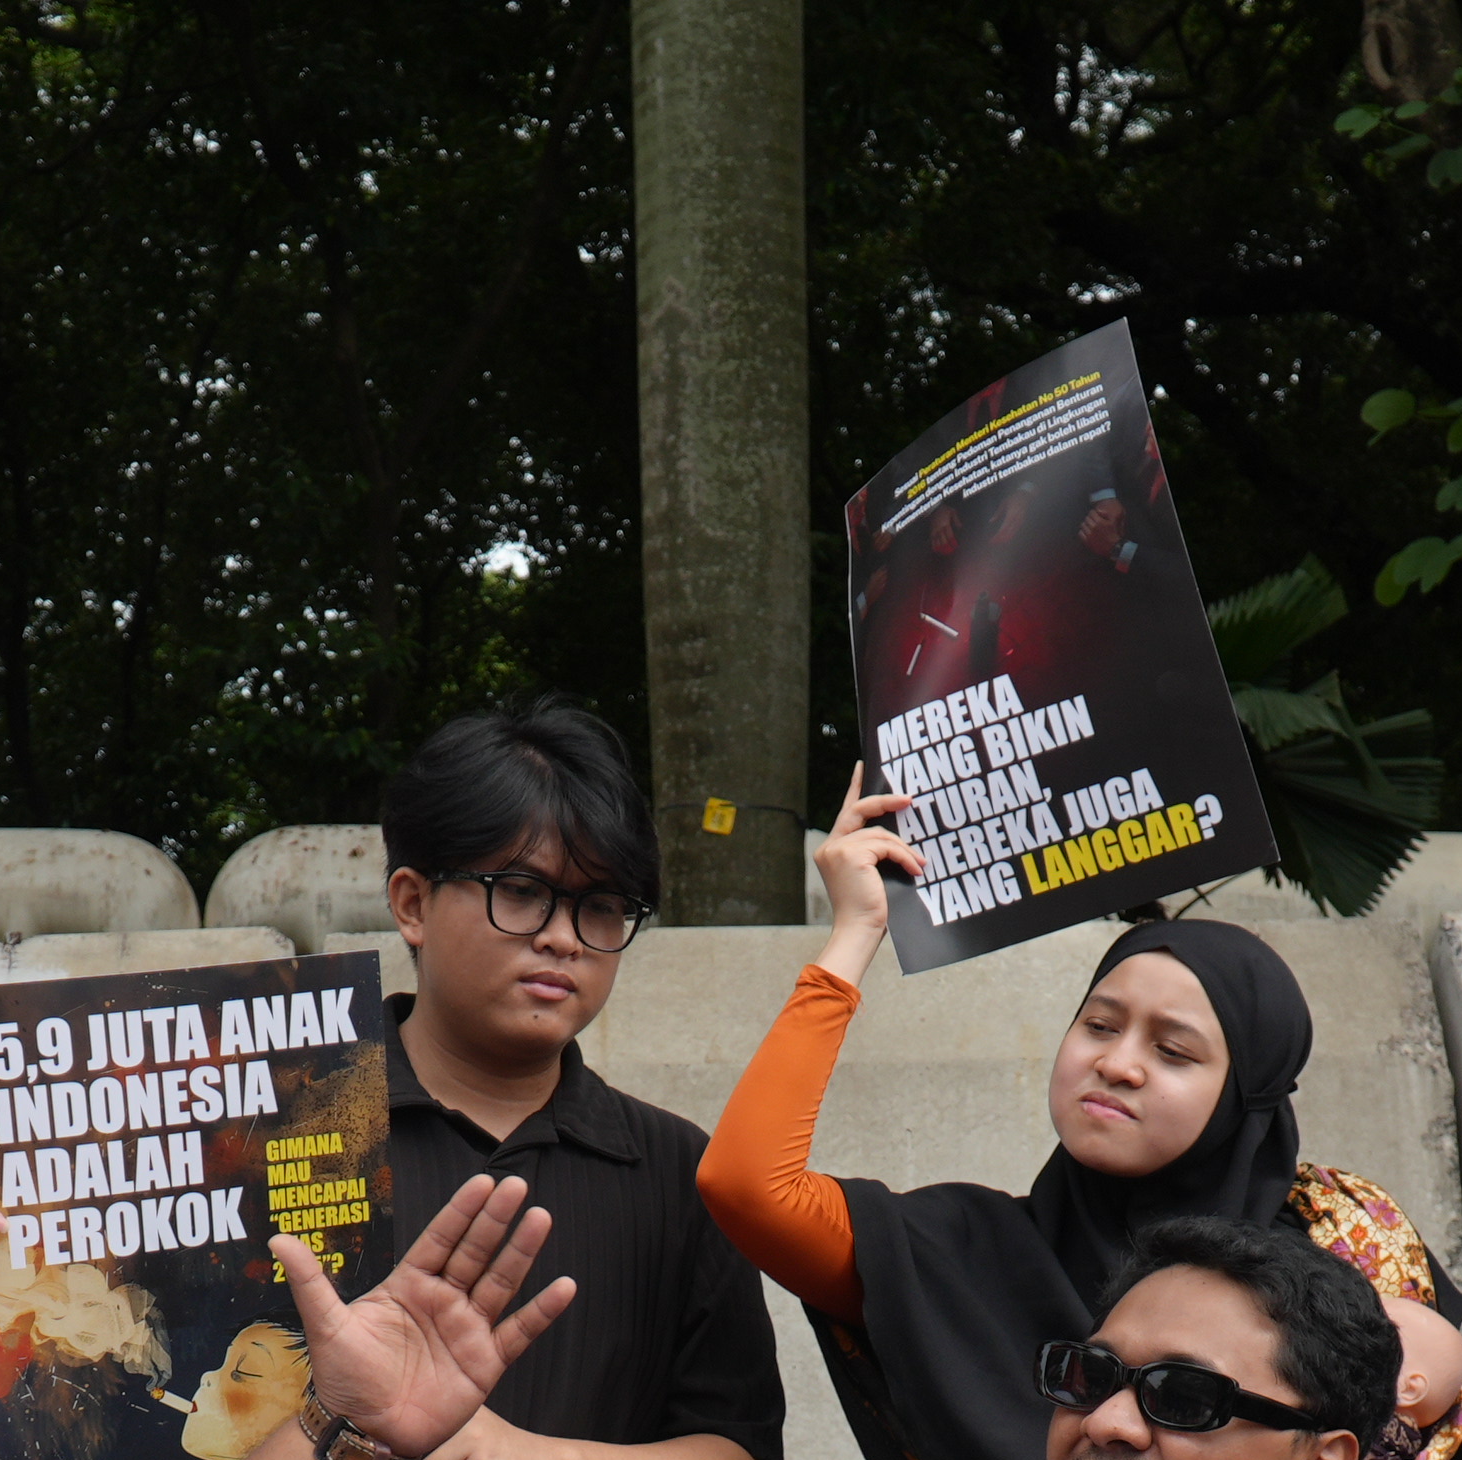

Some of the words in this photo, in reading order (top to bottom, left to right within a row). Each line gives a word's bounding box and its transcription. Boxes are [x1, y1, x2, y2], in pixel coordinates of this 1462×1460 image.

[894, 472, 918, 497] Sesuai
[919, 447, 956, 478] Peraturan
[956, 426, 989, 452] Menteri
[989, 400, 1038, 432] Kesehatan
[1038, 391, 1054, 406] No
[1054, 385, 1069, 398] 50
[1069, 370, 1101, 391] Tahun
[895, 493, 943, 532] Kementerian
[942, 466, 991, 498] Kesehatan,
[990, 445, 1029, 472] katanya
[1029, 436, 1047, 454] gak
[1047, 423, 1076, 443] boleh
[1076, 409, 1110, 430] libatin
[925, 473, 955, 500] dengan
[954, 451, 989, 478] Industri
[988, 428, 1037, 458] Tembakau
[1037, 422, 1047, 433] di
[1047, 396, 1107, 430] Lingkungan
[926, 457, 957, 486] tentang
[956, 435, 998, 464] Pedoman
[997, 405, 1056, 439] Penanganan
[1056, 383, 1104, 410] Benturan
[962, 472, 999, 499] industri
[998, 451, 1047, 480] tembakau
[1047, 438, 1079, 458] dalam
[1079, 421, 1112, 444] rapat?
[877, 673, 1024, 763] MEREKA
[882, 735, 979, 798] YANG
[982, 695, 1095, 767] BIKIN
[896, 760, 1053, 845] ATURAN,
[912, 814, 1063, 886] MEREKA
[1066, 767, 1164, 839] JUGA
[917, 861, 1022, 926] YANG
[1022, 793, 1224, 897] LANGGAR?
[86, 1004, 210, 1071] JUTA
[220, 987, 358, 1057] ANAK
[1, 1130, 205, 1207] ADALAH
[266, 1132, 344, 1162] GIMANA
[267, 1160, 311, 1187] MAU
[8, 1186, 248, 1270] PEROKOK
[268, 1177, 366, 1211] MENCAPAI
